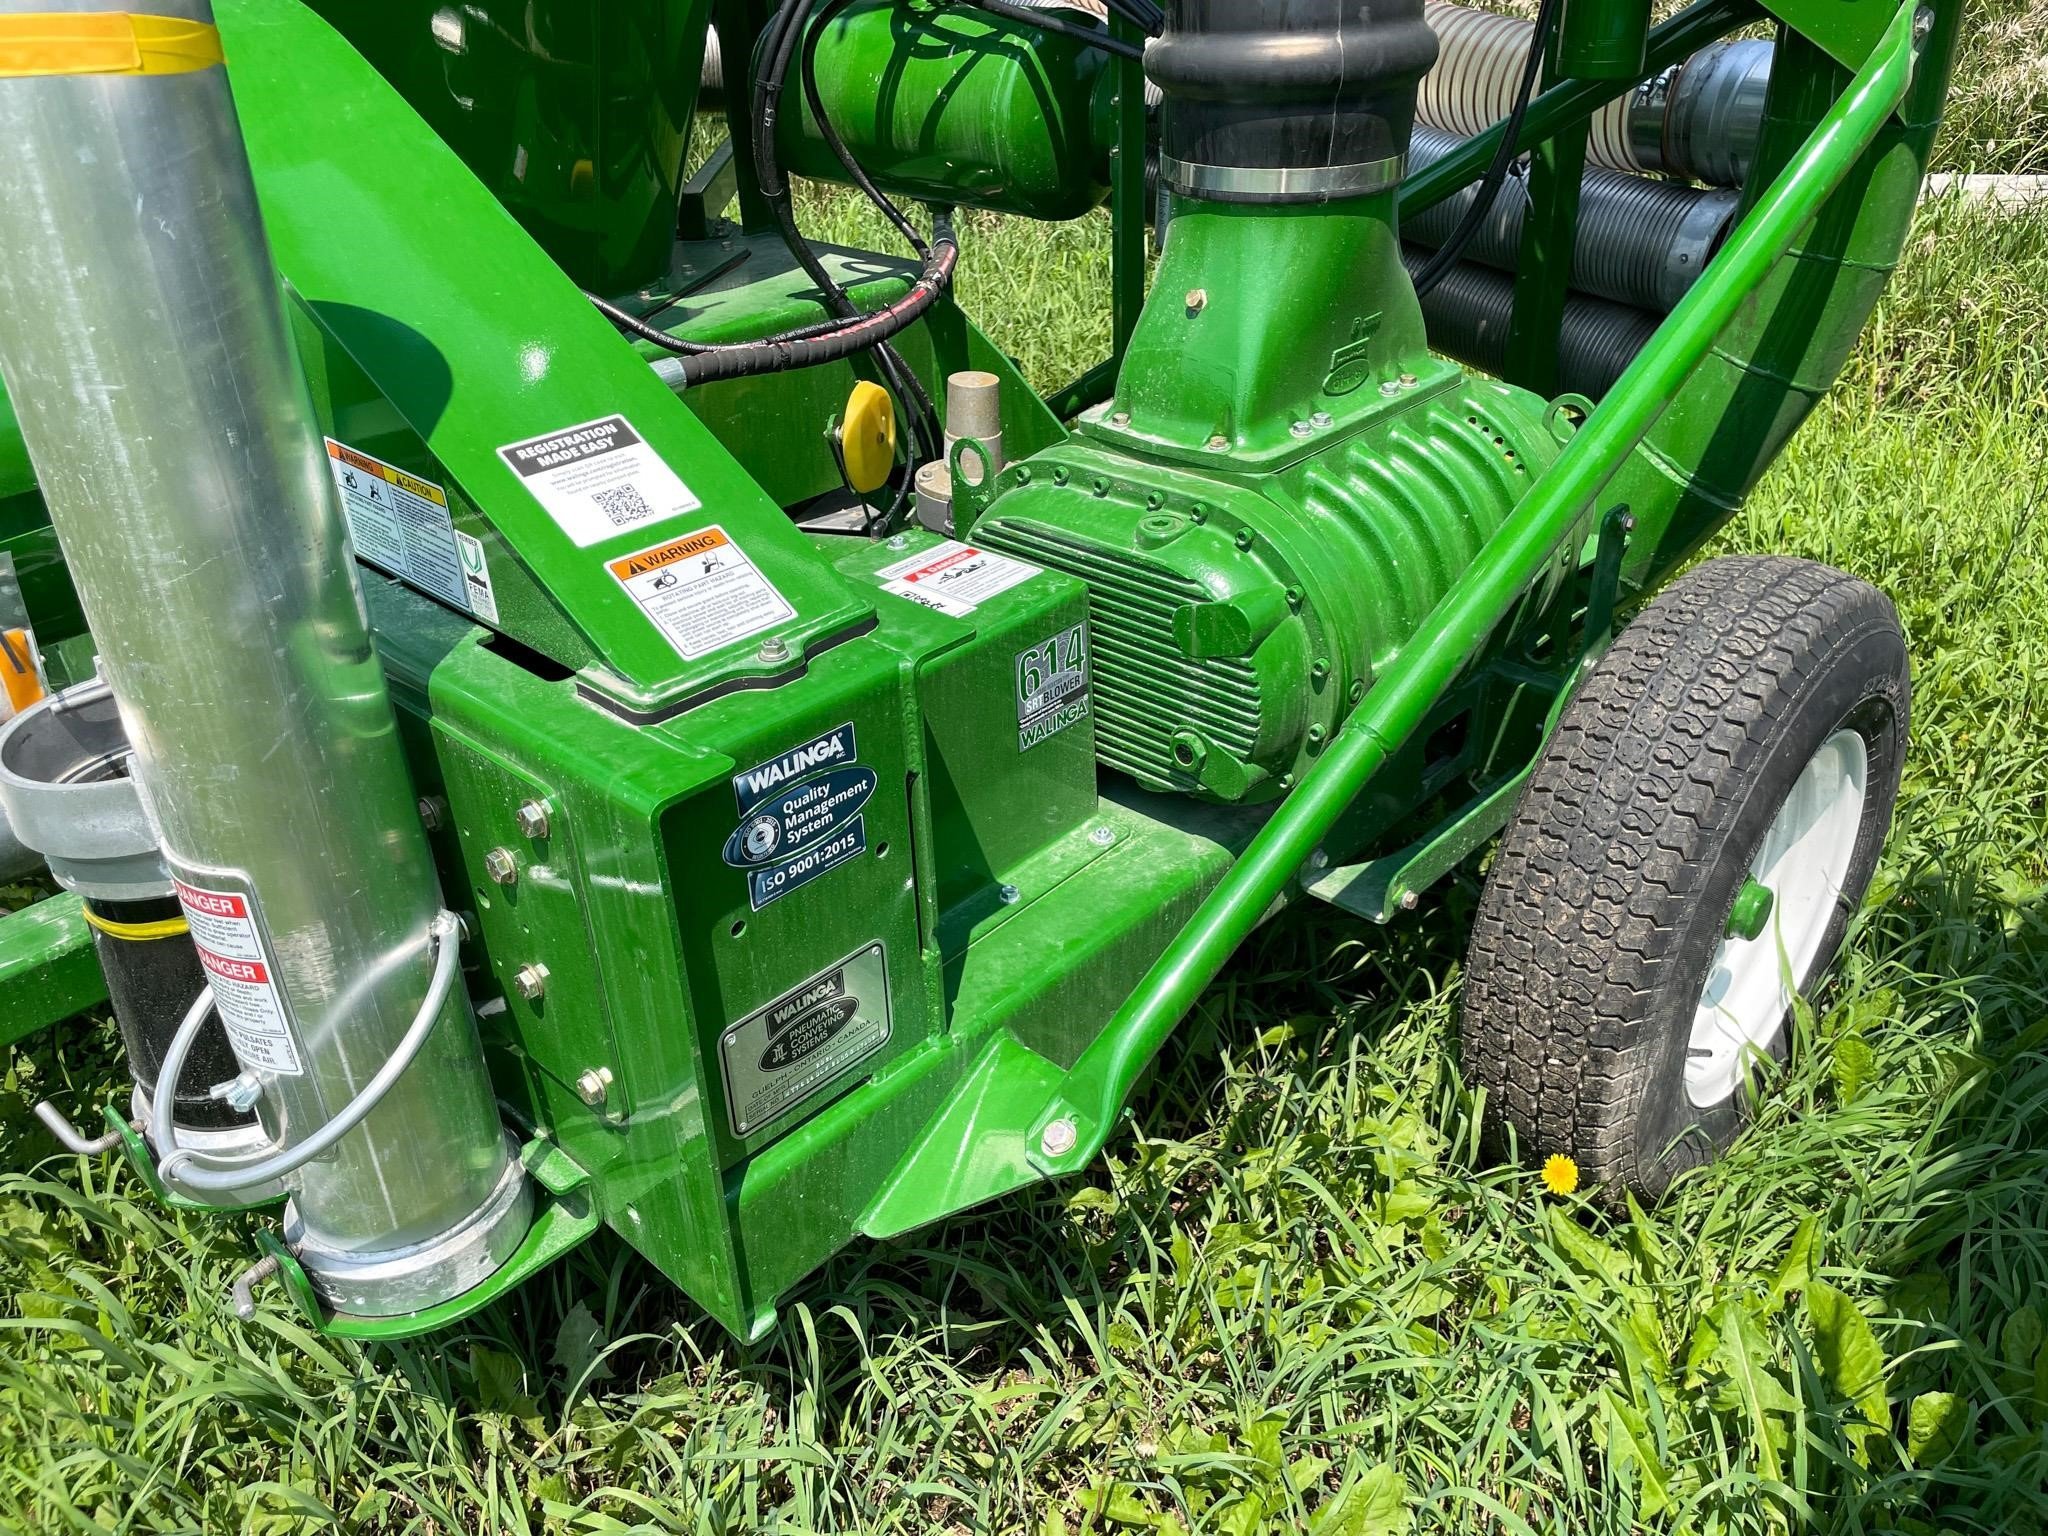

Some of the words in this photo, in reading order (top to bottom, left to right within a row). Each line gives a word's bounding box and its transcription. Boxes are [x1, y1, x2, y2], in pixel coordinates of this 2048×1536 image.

[514, 423, 619, 460] REGISTRATION
[535, 446, 582, 467] MADE
[578, 436, 617, 454] EASY
[345, 452, 374, 472] WARNING
[402, 477, 432, 497] CAUTION
[642, 534, 717, 567] WARNING
[928, 551, 971, 573] DANGER
[469, 582, 489, 599] FEMA
[1019, 625, 1086, 704] 614
[746, 731, 844, 795] WALINGA
[781, 781, 831, 815] Quality
[783, 778, 868, 830] Management
[786, 811, 834, 846] System
[760, 869, 786, 893] ISO
[787, 832, 856, 878] 9001:2015
[177, 883, 234, 914] DANGER
[199, 952, 256, 979] DANGER
[232, 982, 259, 991] HAZARD
[773, 977, 836, 1025] WALINGA
[788, 1002, 840, 1040] PNEUMATIC
[789, 1008, 844, 1049] CONVEYING
[751, 1072, 787, 1100] GUELPH
[793, 1043, 831, 1072] ONTARIO
[837, 1018, 870, 1044] CANADA
[791, 1028, 828, 1059] SYSTEMS
